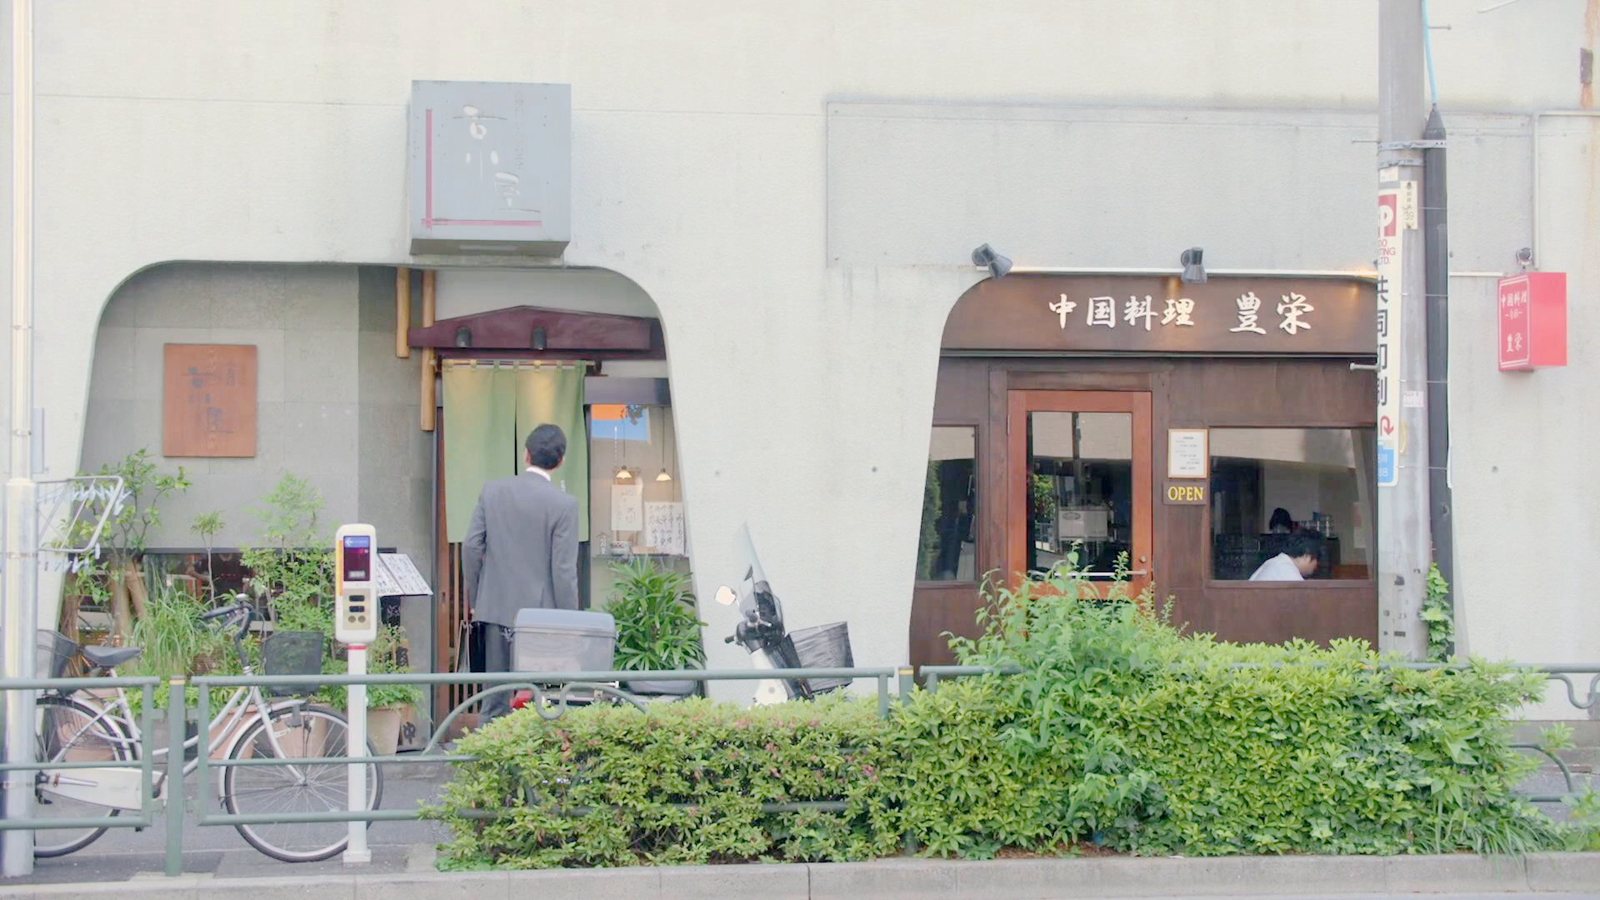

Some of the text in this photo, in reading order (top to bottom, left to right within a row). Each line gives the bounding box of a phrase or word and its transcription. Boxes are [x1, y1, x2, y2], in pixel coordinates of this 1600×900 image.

[1049, 291, 1315, 334] 中国料理 豊栄
[1168, 486, 1204, 501] OPEN
